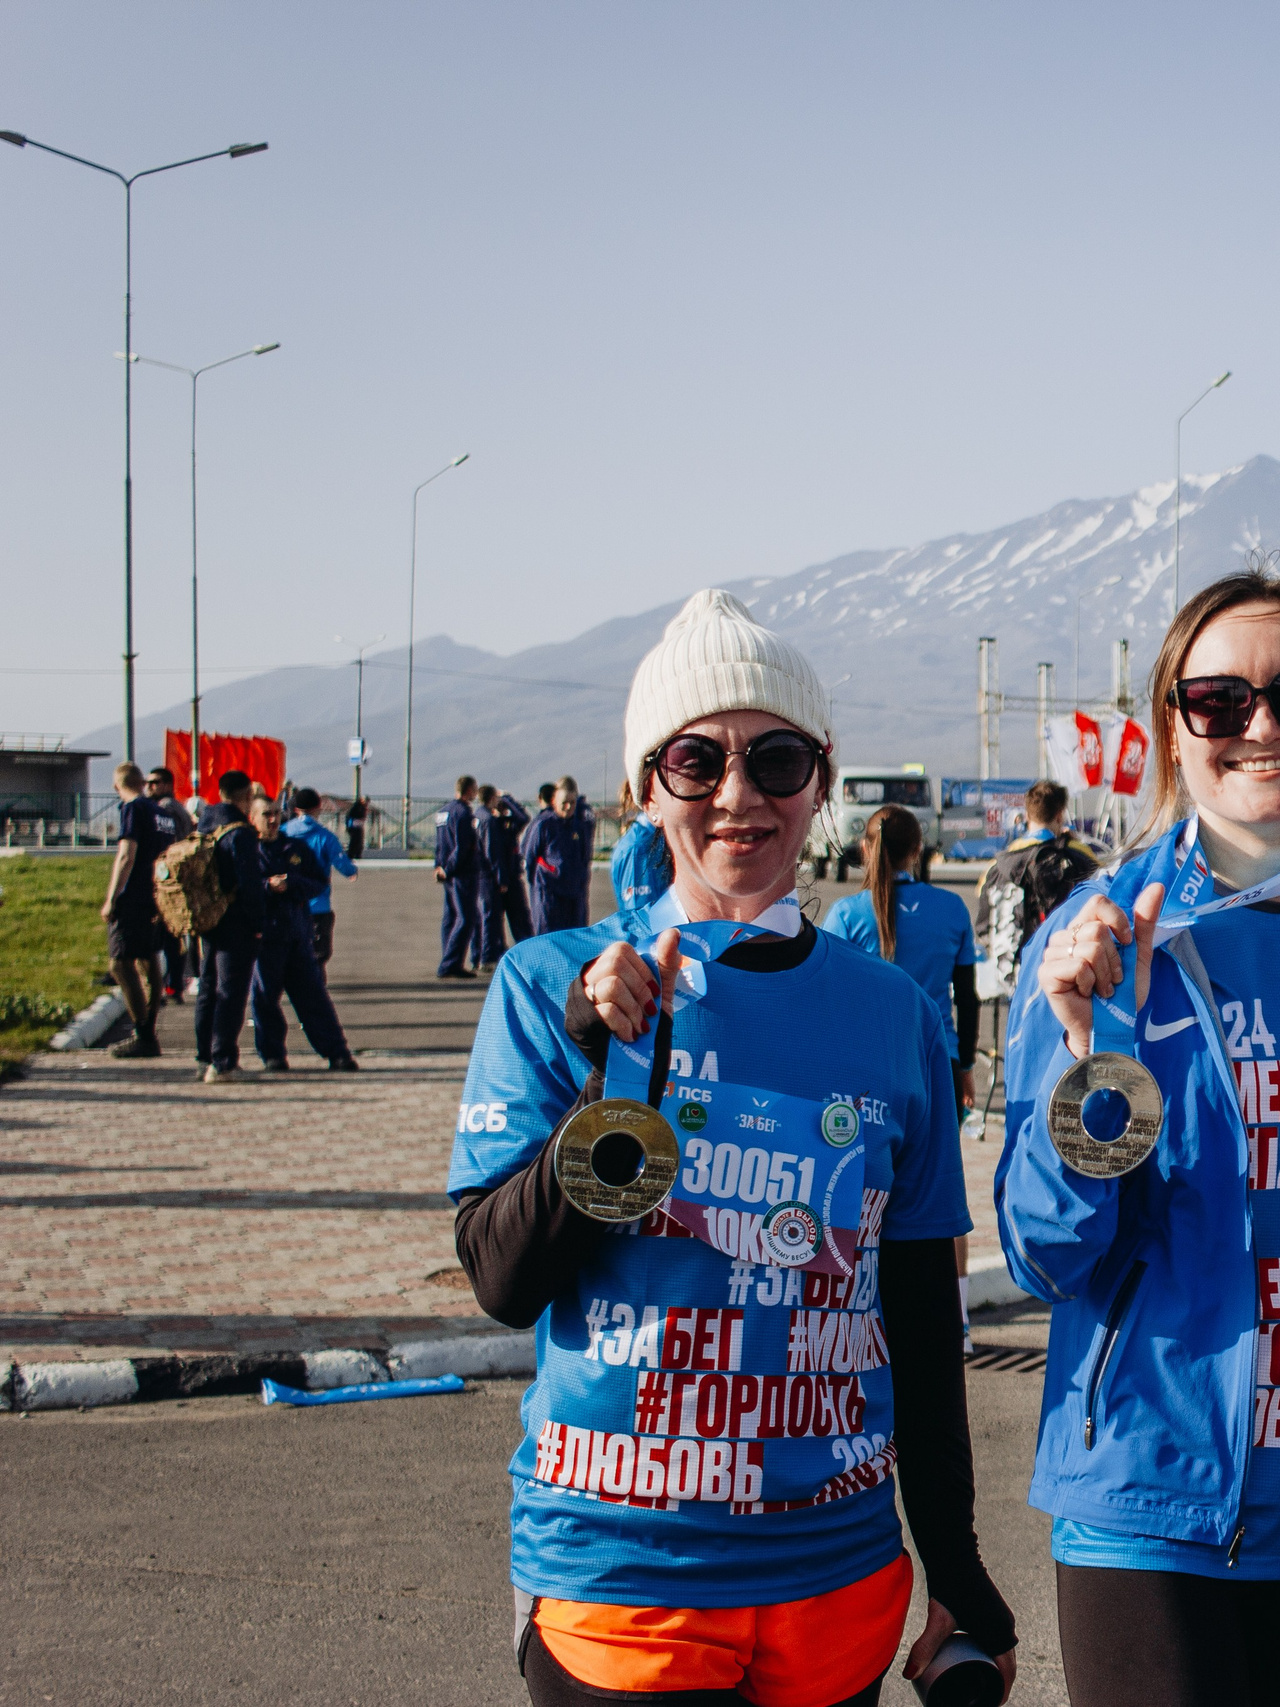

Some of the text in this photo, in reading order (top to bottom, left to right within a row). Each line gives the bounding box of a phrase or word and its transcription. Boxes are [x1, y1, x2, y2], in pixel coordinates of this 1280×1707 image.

[1180, 875, 1204, 906] ПСБ
[678, 1085, 713, 1103] ПСБ
[681, 1138, 816, 1205] 30051
[766, 1231, 812, 1261] ЛИШНЕМУ ВЕСУ!
[796, 1210, 816, 1241] ВЫЗОВ
[585, 1298, 744, 1371] #ЗАБЕГ
[635, 1371, 866, 1439] #ГОРДОСТЬ
[535, 1419, 765, 1502] #ЛЮБОВЬ
